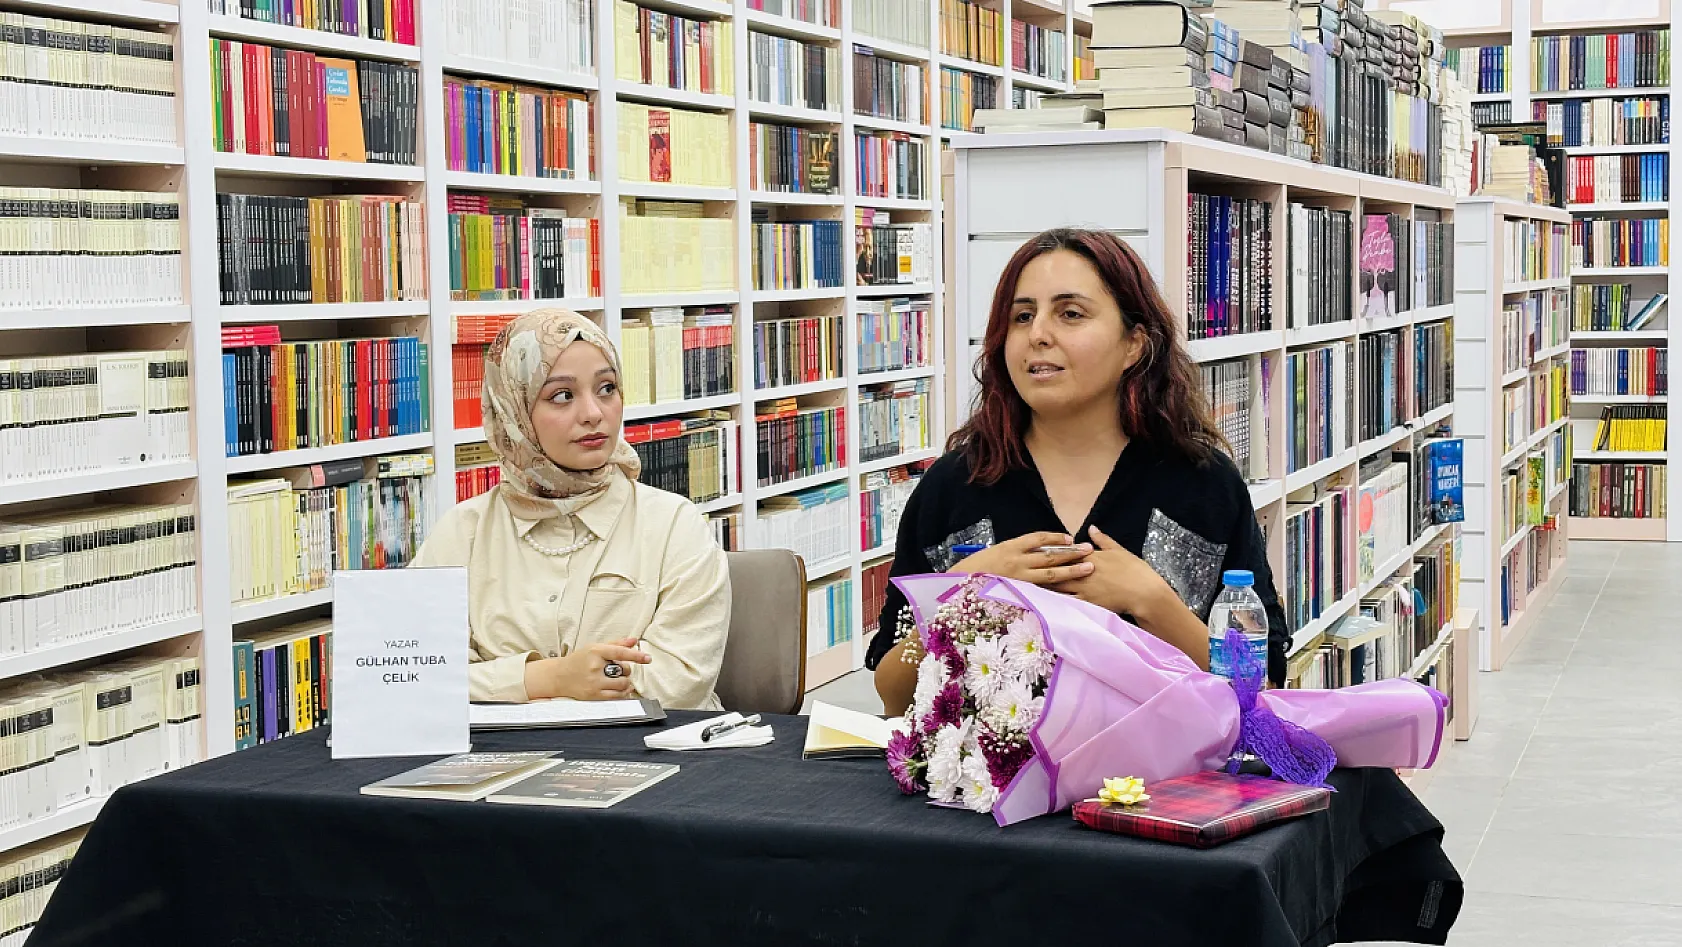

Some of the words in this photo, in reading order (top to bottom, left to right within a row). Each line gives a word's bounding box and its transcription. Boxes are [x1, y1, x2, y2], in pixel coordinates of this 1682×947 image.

[384, 640, 420, 649] YAZAR
[356, 655, 409, 667] GÜLHAN
[412, 655, 447, 665] TUBA
[382, 671, 420, 685] ÇELİK
